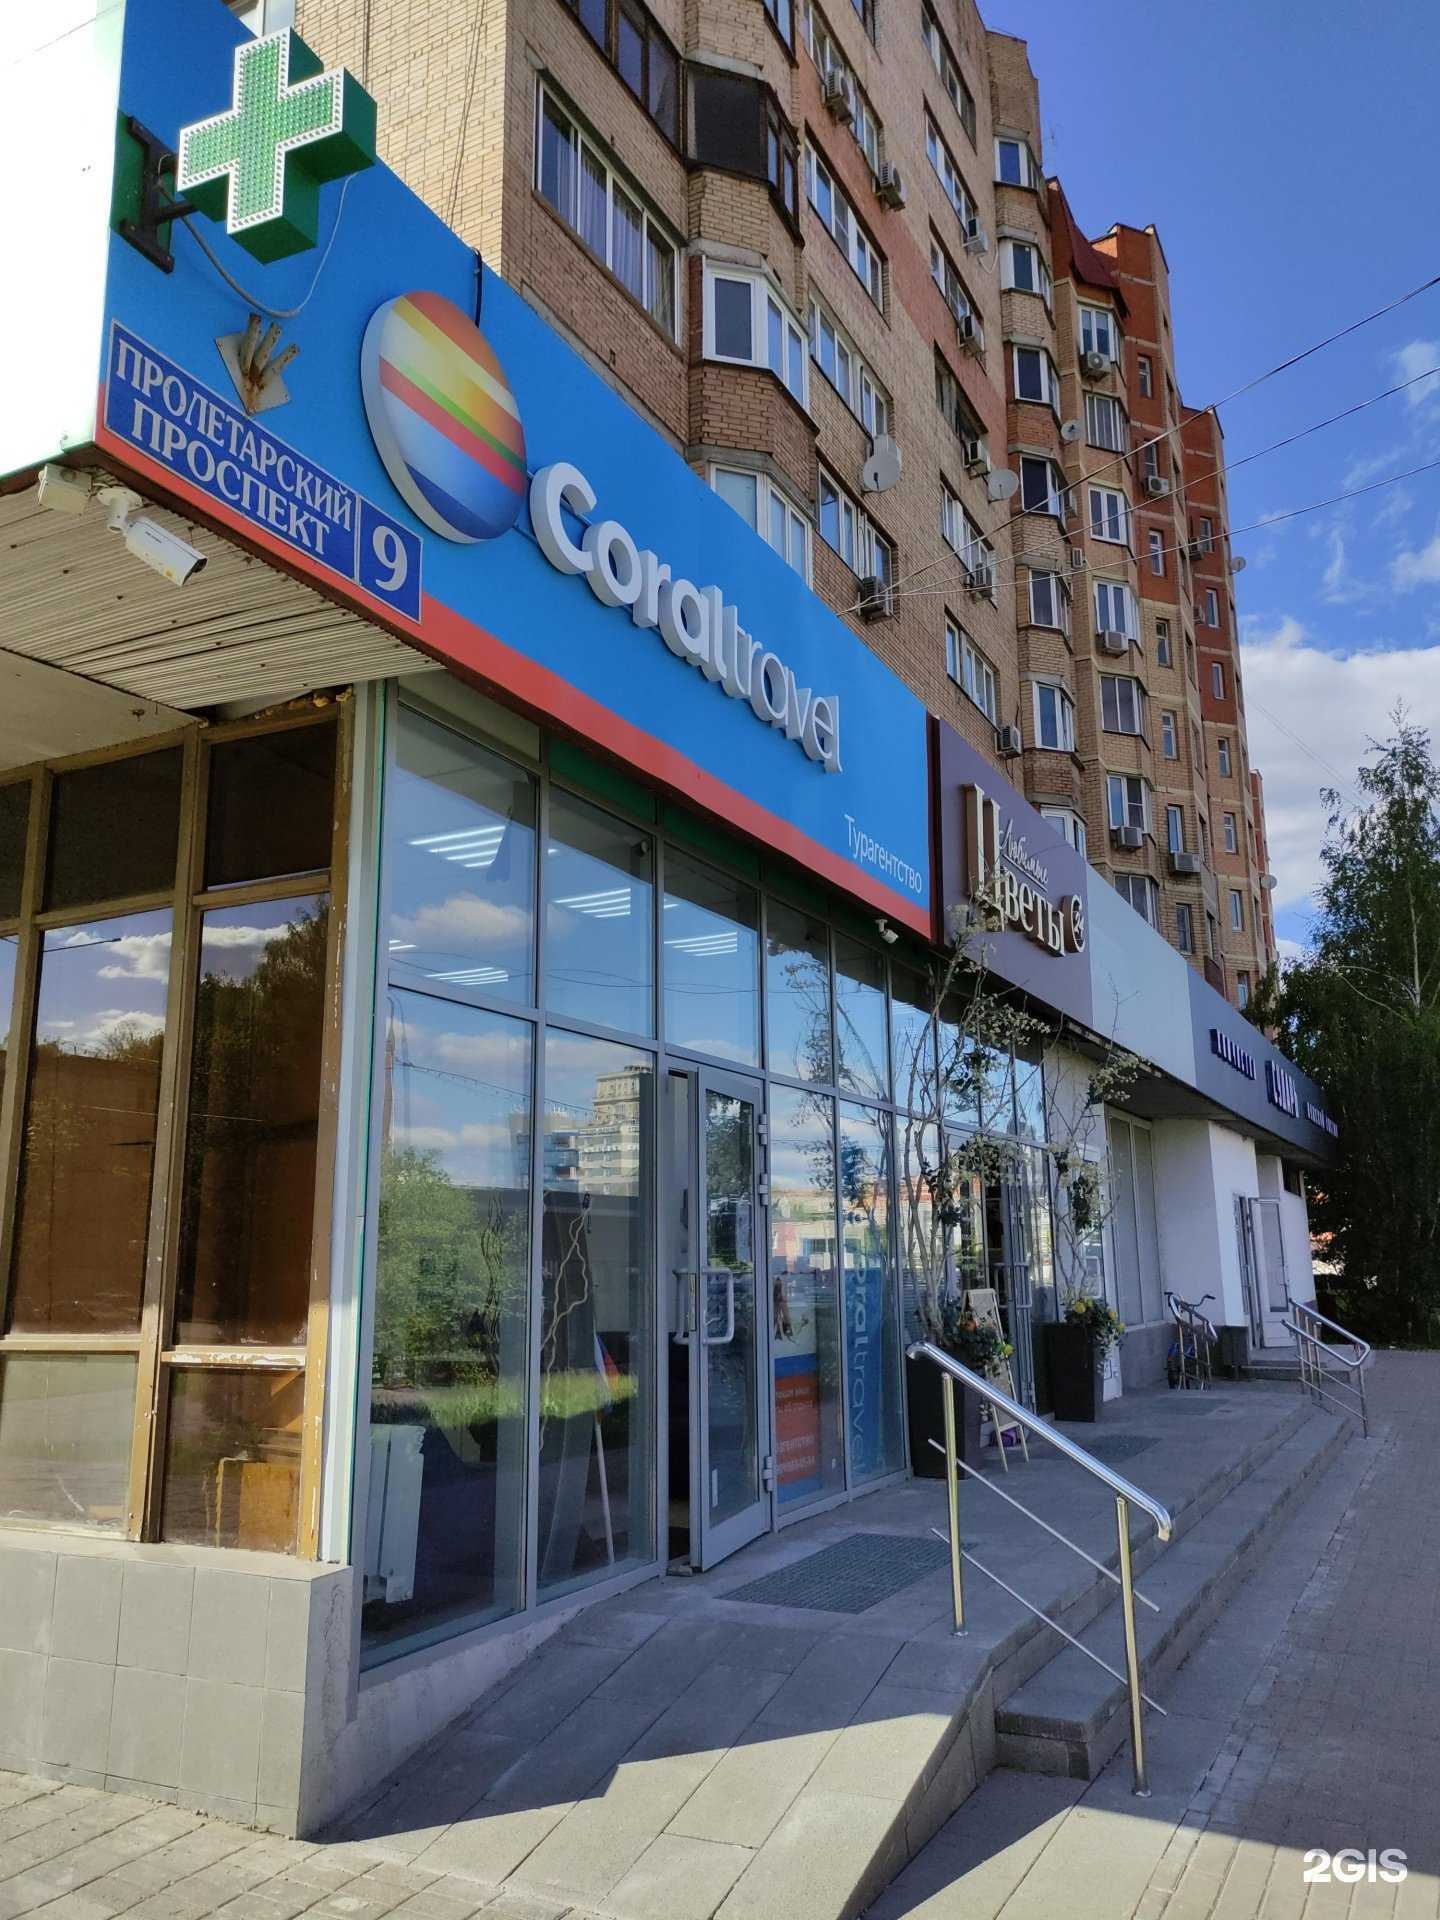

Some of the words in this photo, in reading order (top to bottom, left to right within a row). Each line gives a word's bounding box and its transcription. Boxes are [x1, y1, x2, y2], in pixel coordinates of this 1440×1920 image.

[116, 337, 353, 532] ПРОЛЕТАРСКИЙ
[131, 398, 330, 555] ПРОСПЕКТ
[372, 525, 408, 592] 9
[844, 814, 922, 894] Турагентство
